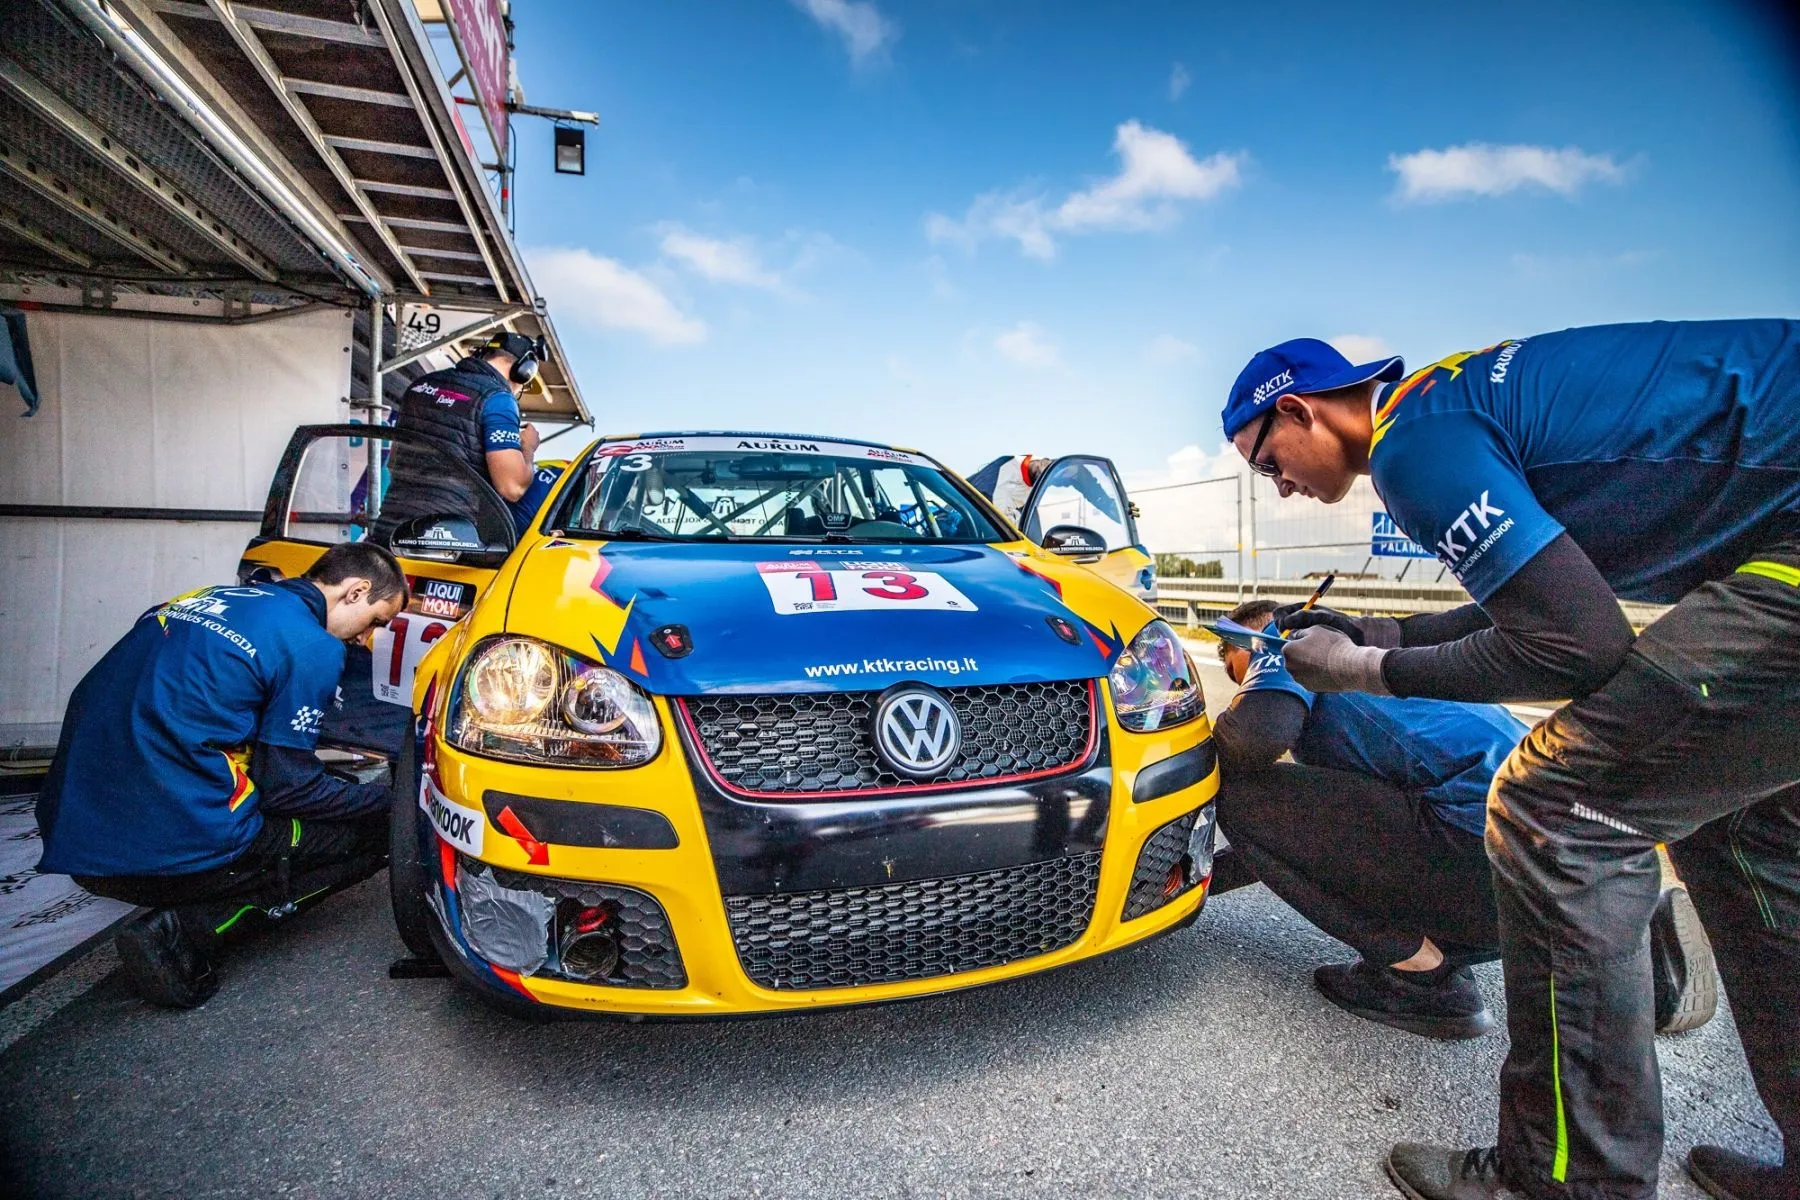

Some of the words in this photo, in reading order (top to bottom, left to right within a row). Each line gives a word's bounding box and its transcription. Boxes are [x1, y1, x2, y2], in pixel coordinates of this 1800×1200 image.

[407, 311, 441, 333] 49
[1265, 367, 1294, 393] KTK
[737, 439, 821, 452] AURUM
[591, 454, 653, 474] 13
[826, 514, 845, 523] OMP
[1436, 489, 1505, 562] KTK
[1479, 516, 1516, 552] DIVISION
[1380, 540, 1430, 554] PALANG
[426, 582, 462, 600] LIQUI
[795, 571, 930, 602] 13
[423, 597, 459, 615] MOLY
[202, 619, 258, 658] KOLEGIJA
[803, 656, 979, 678] www.ktkracing.lt
